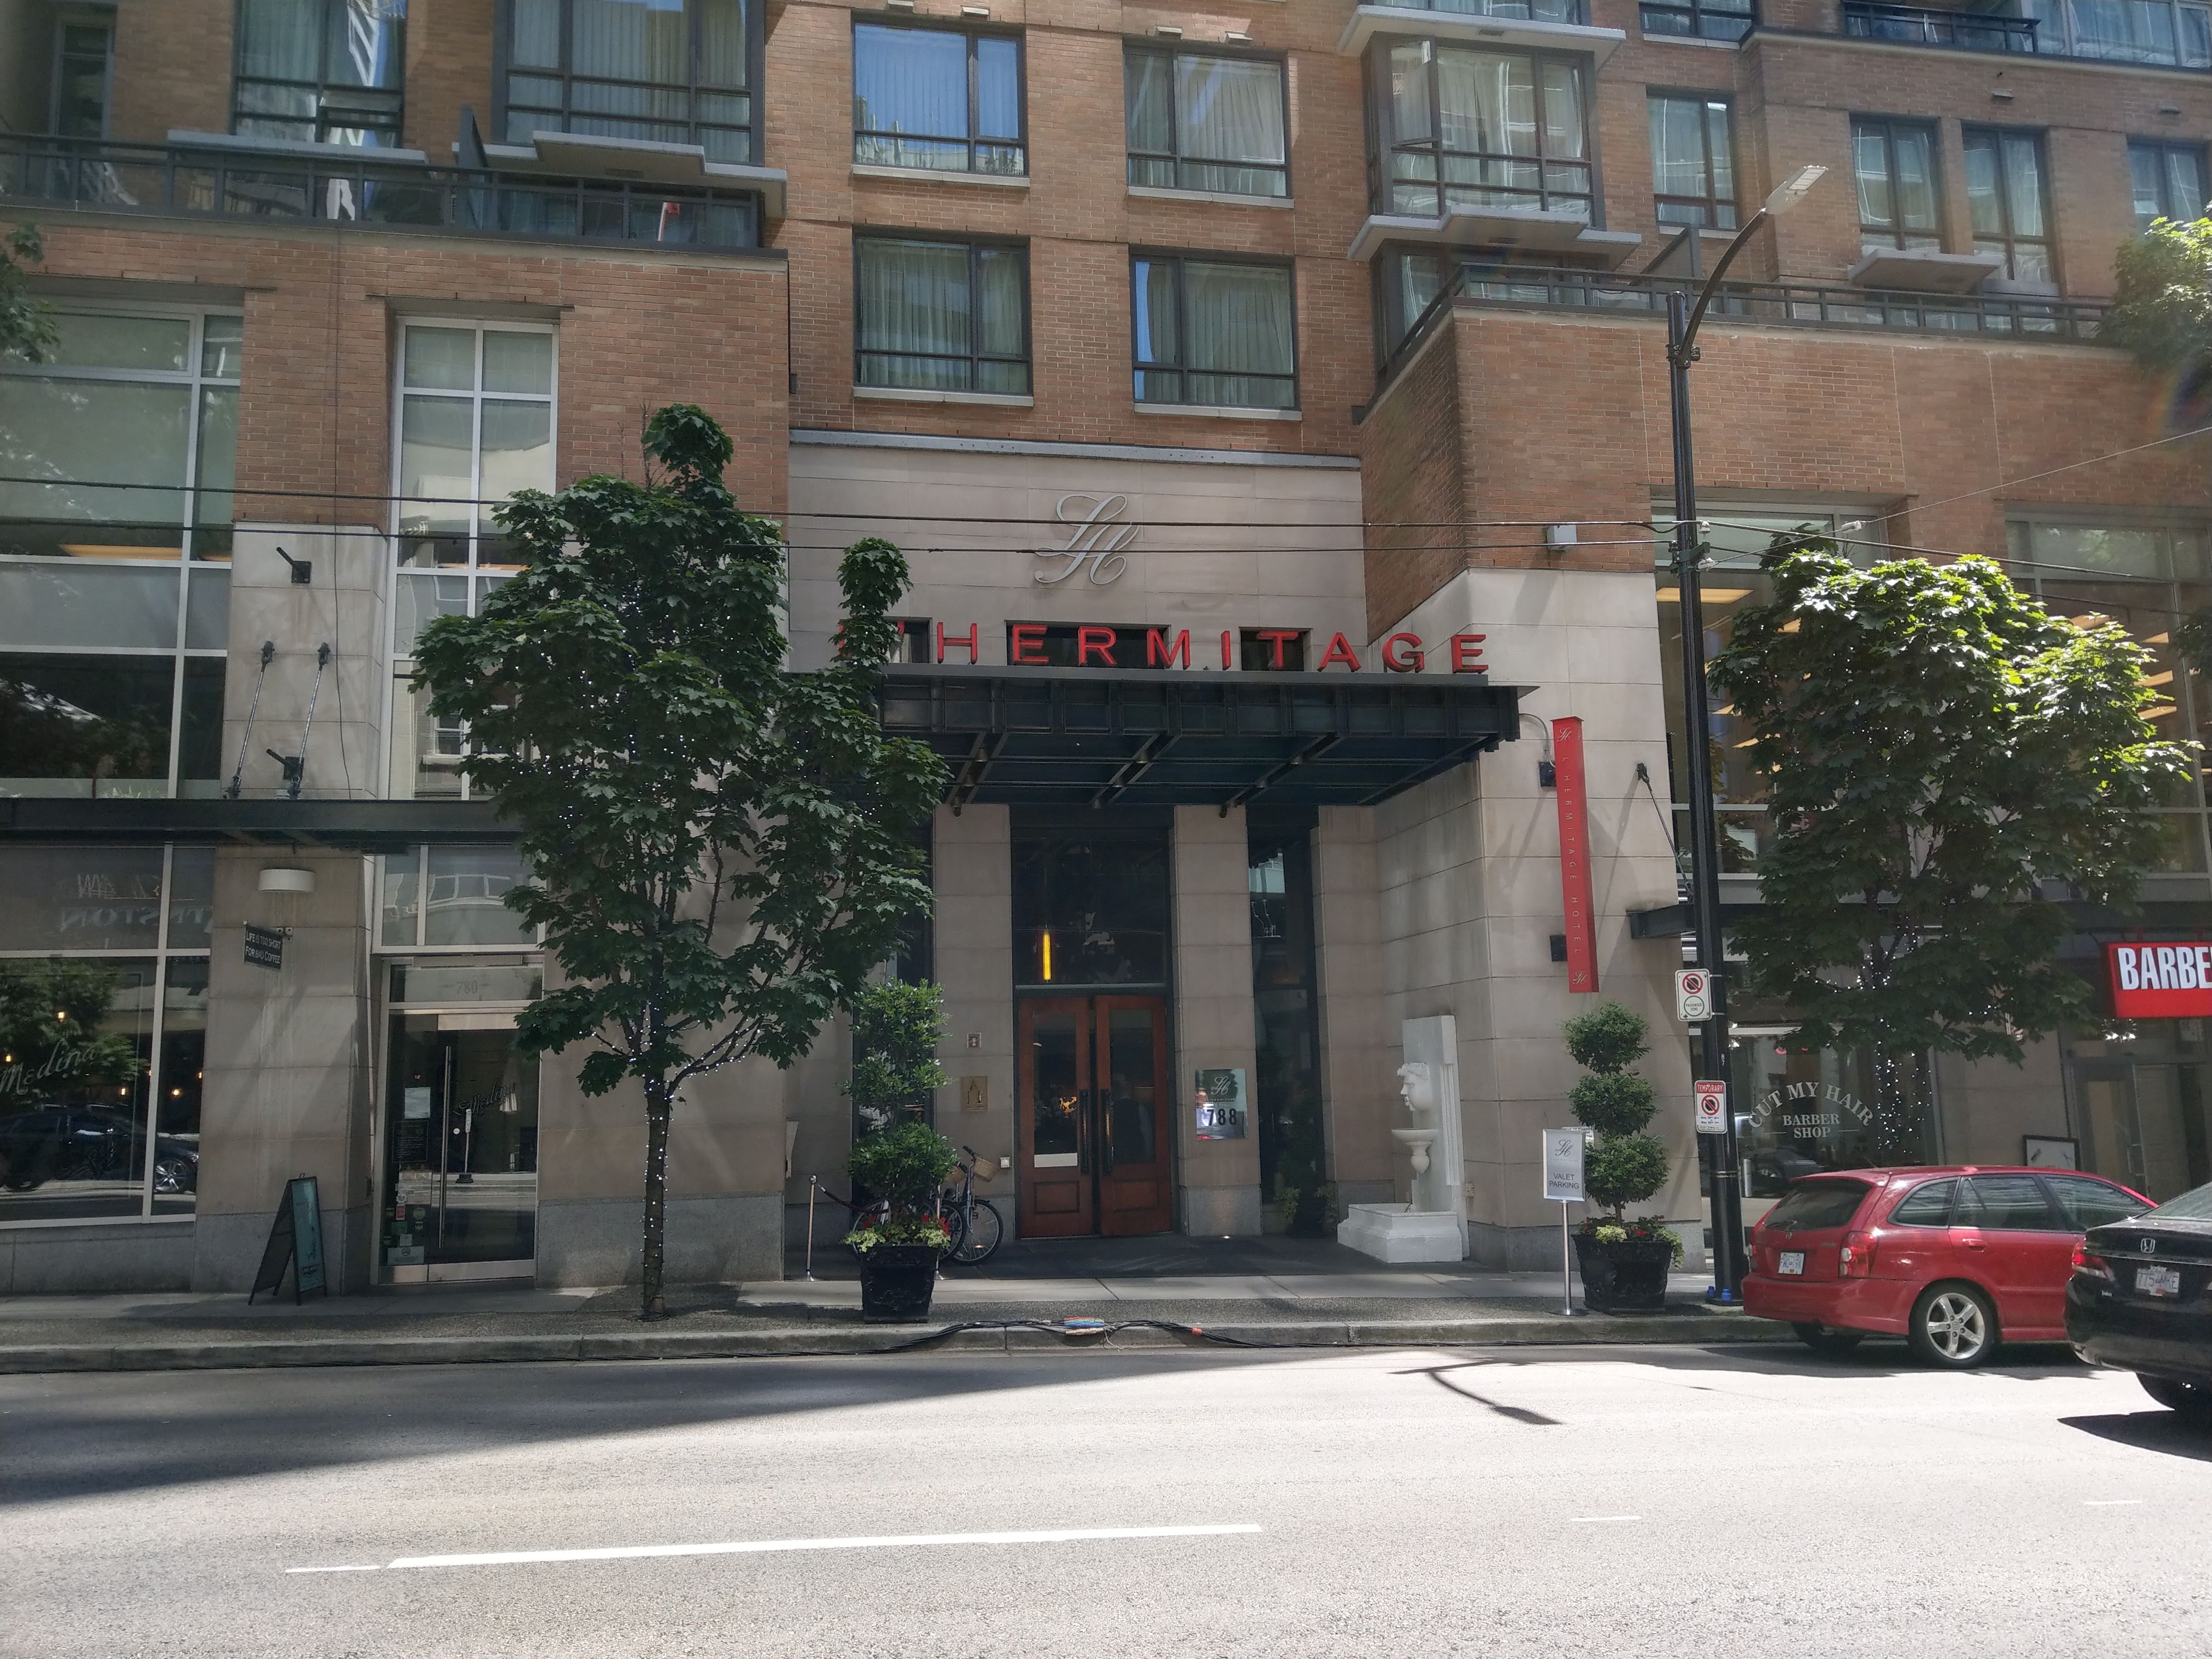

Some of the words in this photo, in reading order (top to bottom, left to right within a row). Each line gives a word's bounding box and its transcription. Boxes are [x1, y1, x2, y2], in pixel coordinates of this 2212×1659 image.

[1571, 897, 1581, 953] HOTEL
[246, 930, 256, 943] LIFE
[255, 935, 260, 944] IS
[260, 936, 268, 946] TOO
[268, 938, 281, 949] SHORT
[245, 946, 255, 957] FOR
[255, 949, 264, 960] BAD
[264, 951, 281, 964] COFFEE
[2118, 947, 2212, 990] BARBE
[1697, 1084, 1723, 1092] TEMPORARY
[1748, 1090, 1782, 1128] CUT
[1786, 1082, 1819, 1101] MY
[1825, 1084, 1874, 1126] HAIR
[1207, 1108, 1237, 1126] 788
[1783, 1114, 1839, 1126] BARBER
[1794, 1127, 1831, 1138] SHOP
[1549, 1181, 1579, 1189] PARKING
